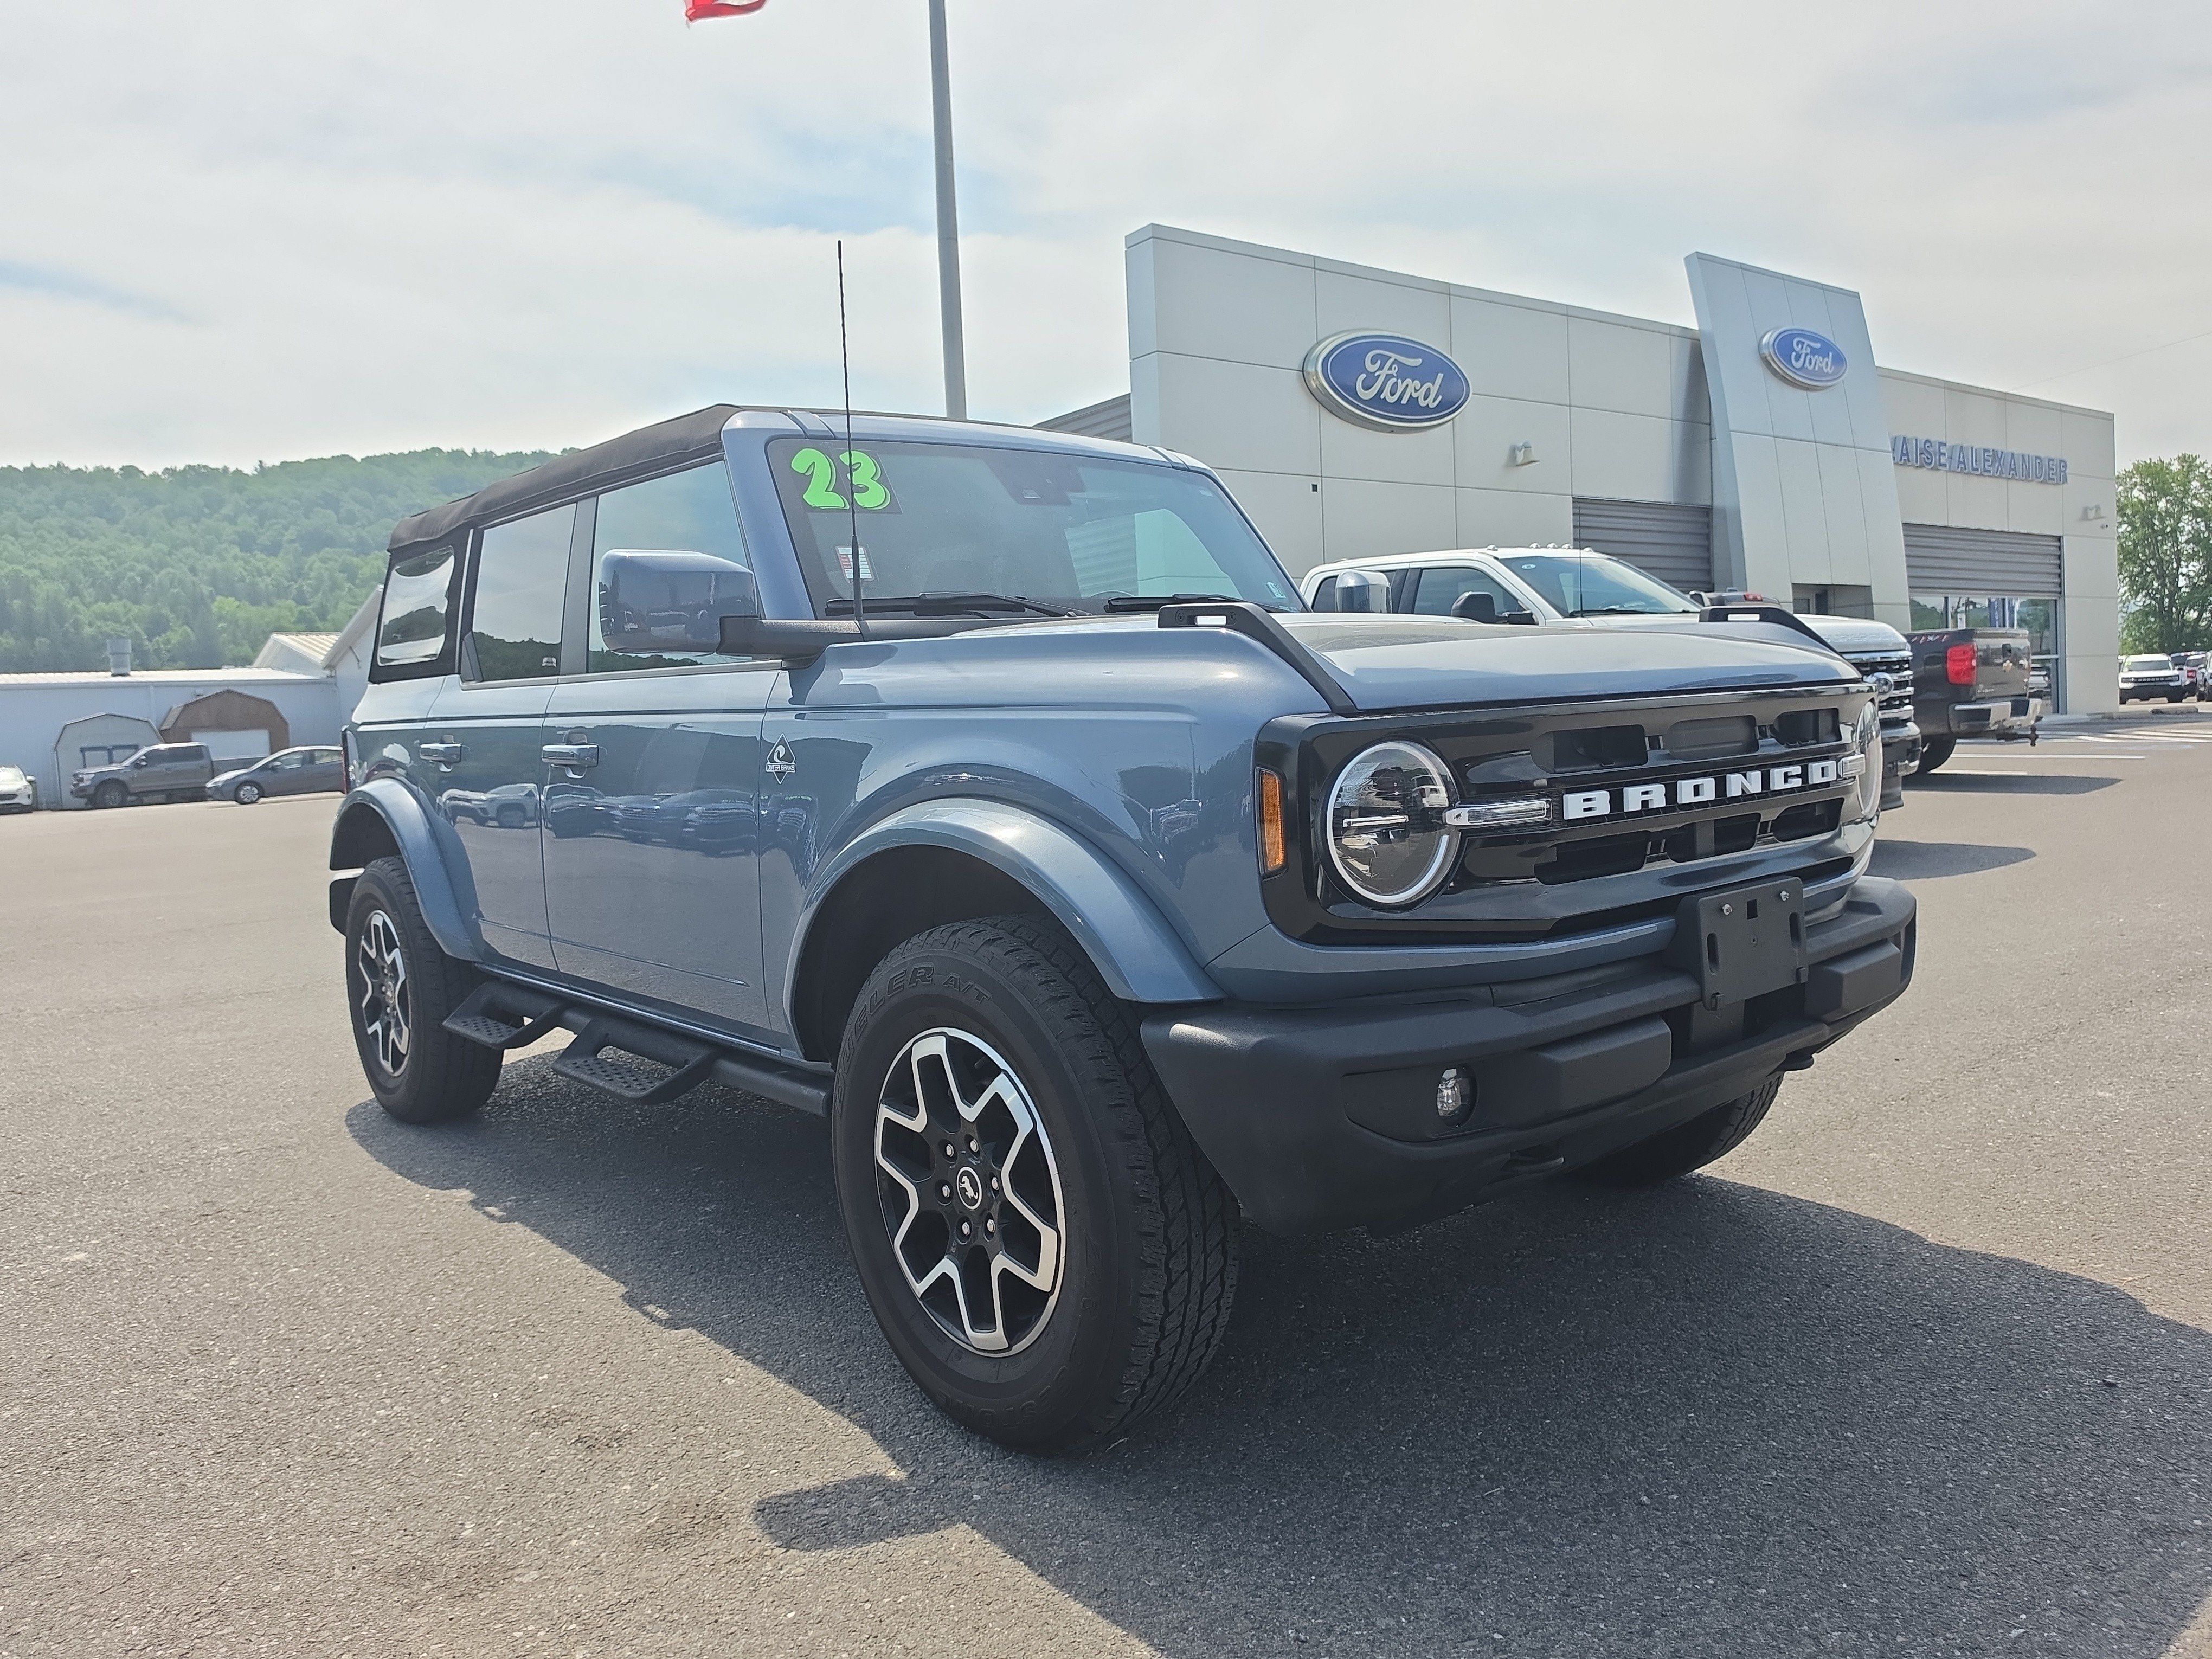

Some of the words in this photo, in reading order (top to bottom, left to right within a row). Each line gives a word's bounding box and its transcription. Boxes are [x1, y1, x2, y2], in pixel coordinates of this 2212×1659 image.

[1355, 349, 1443, 409] Ford
[1791, 337, 1834, 374] Ford
[790, 448, 891, 510] 23
[1892, 435, 1949, 471] AISE
[1956, 445, 2069, 485] ALEXANDER
[1563, 760, 1837, 820] BRONCO
[942, 972, 993, 1004] A/T
